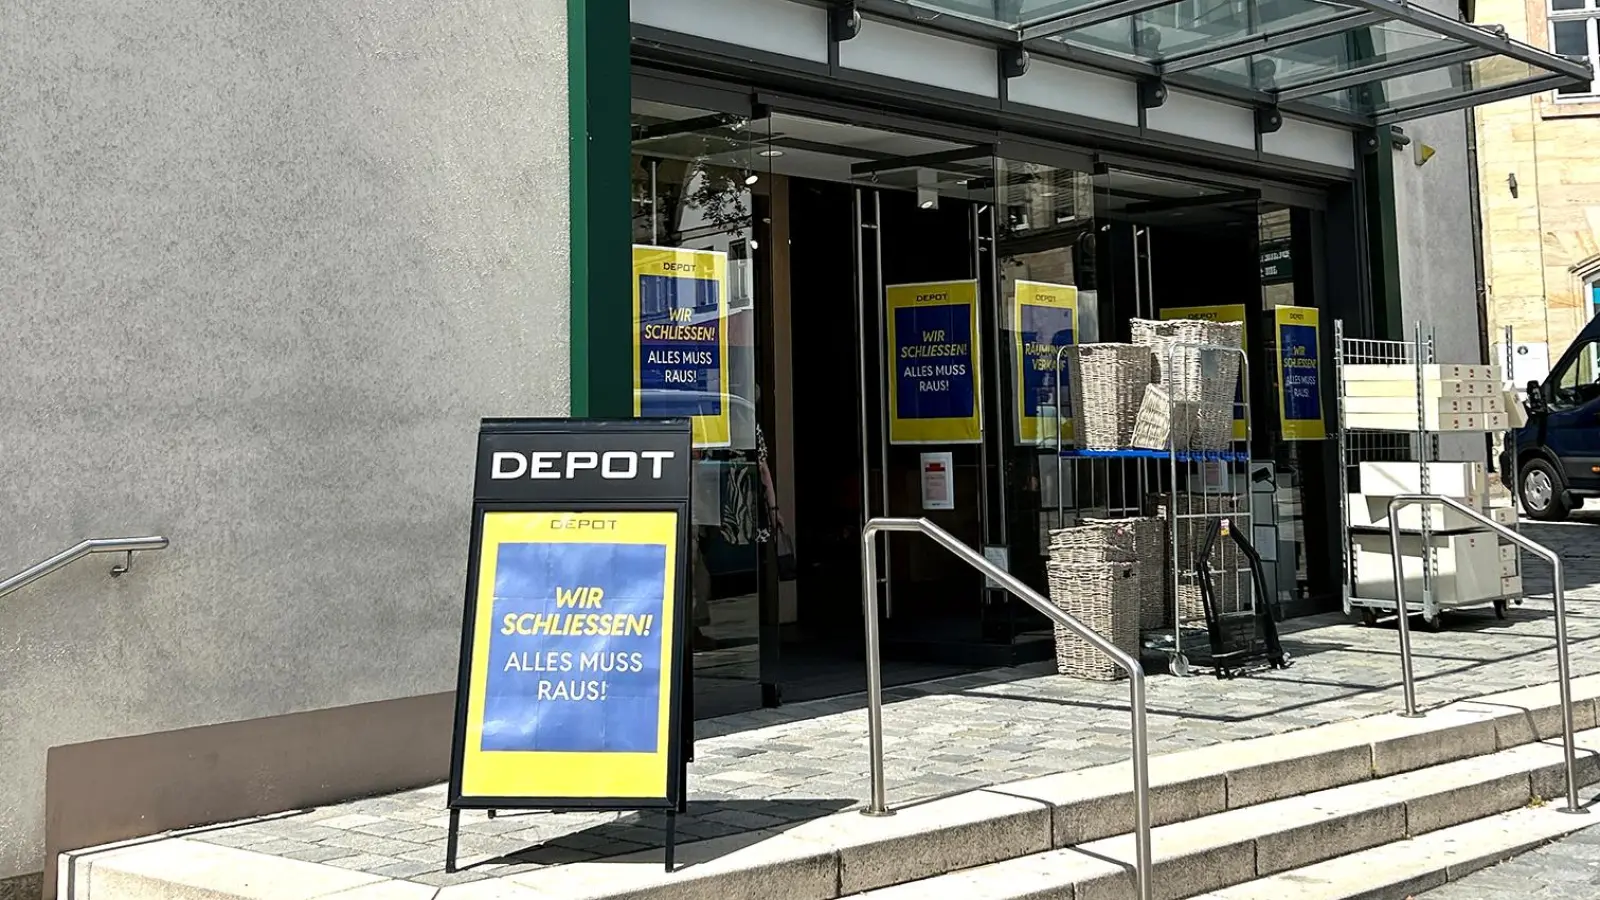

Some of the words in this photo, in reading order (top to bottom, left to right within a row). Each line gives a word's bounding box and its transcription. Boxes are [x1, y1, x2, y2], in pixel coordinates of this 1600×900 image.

[663, 262, 697, 272] DEPOT
[916, 293, 948, 302] DEPOT
[1035, 294, 1056, 302] DEPOT
[669, 307, 693, 322] WIR
[1188, 312, 1218, 320] DEPOT
[644, 324, 716, 341] SCHLIESSEN!
[922, 330, 945, 342] WIR
[648, 350, 680, 364] ALLES
[682, 351, 713, 366] MUSS
[900, 344, 968, 358] SCHLIESSEN!
[664, 369, 697, 383] RAUS!
[904, 365, 933, 377] ALLES
[936, 364, 966, 376] MUSS
[919, 380, 949, 392] RAUS!
[491, 451, 675, 479] DEPOT
[550, 519, 617, 530] DEPOT
[555, 586, 604, 609] WIR
[500, 613, 653, 637] SCHLIESSEN!
[503, 651, 573, 672] ALLES
[579, 652, 643, 672] MUSS
[537, 680, 607, 701] RAUS!
